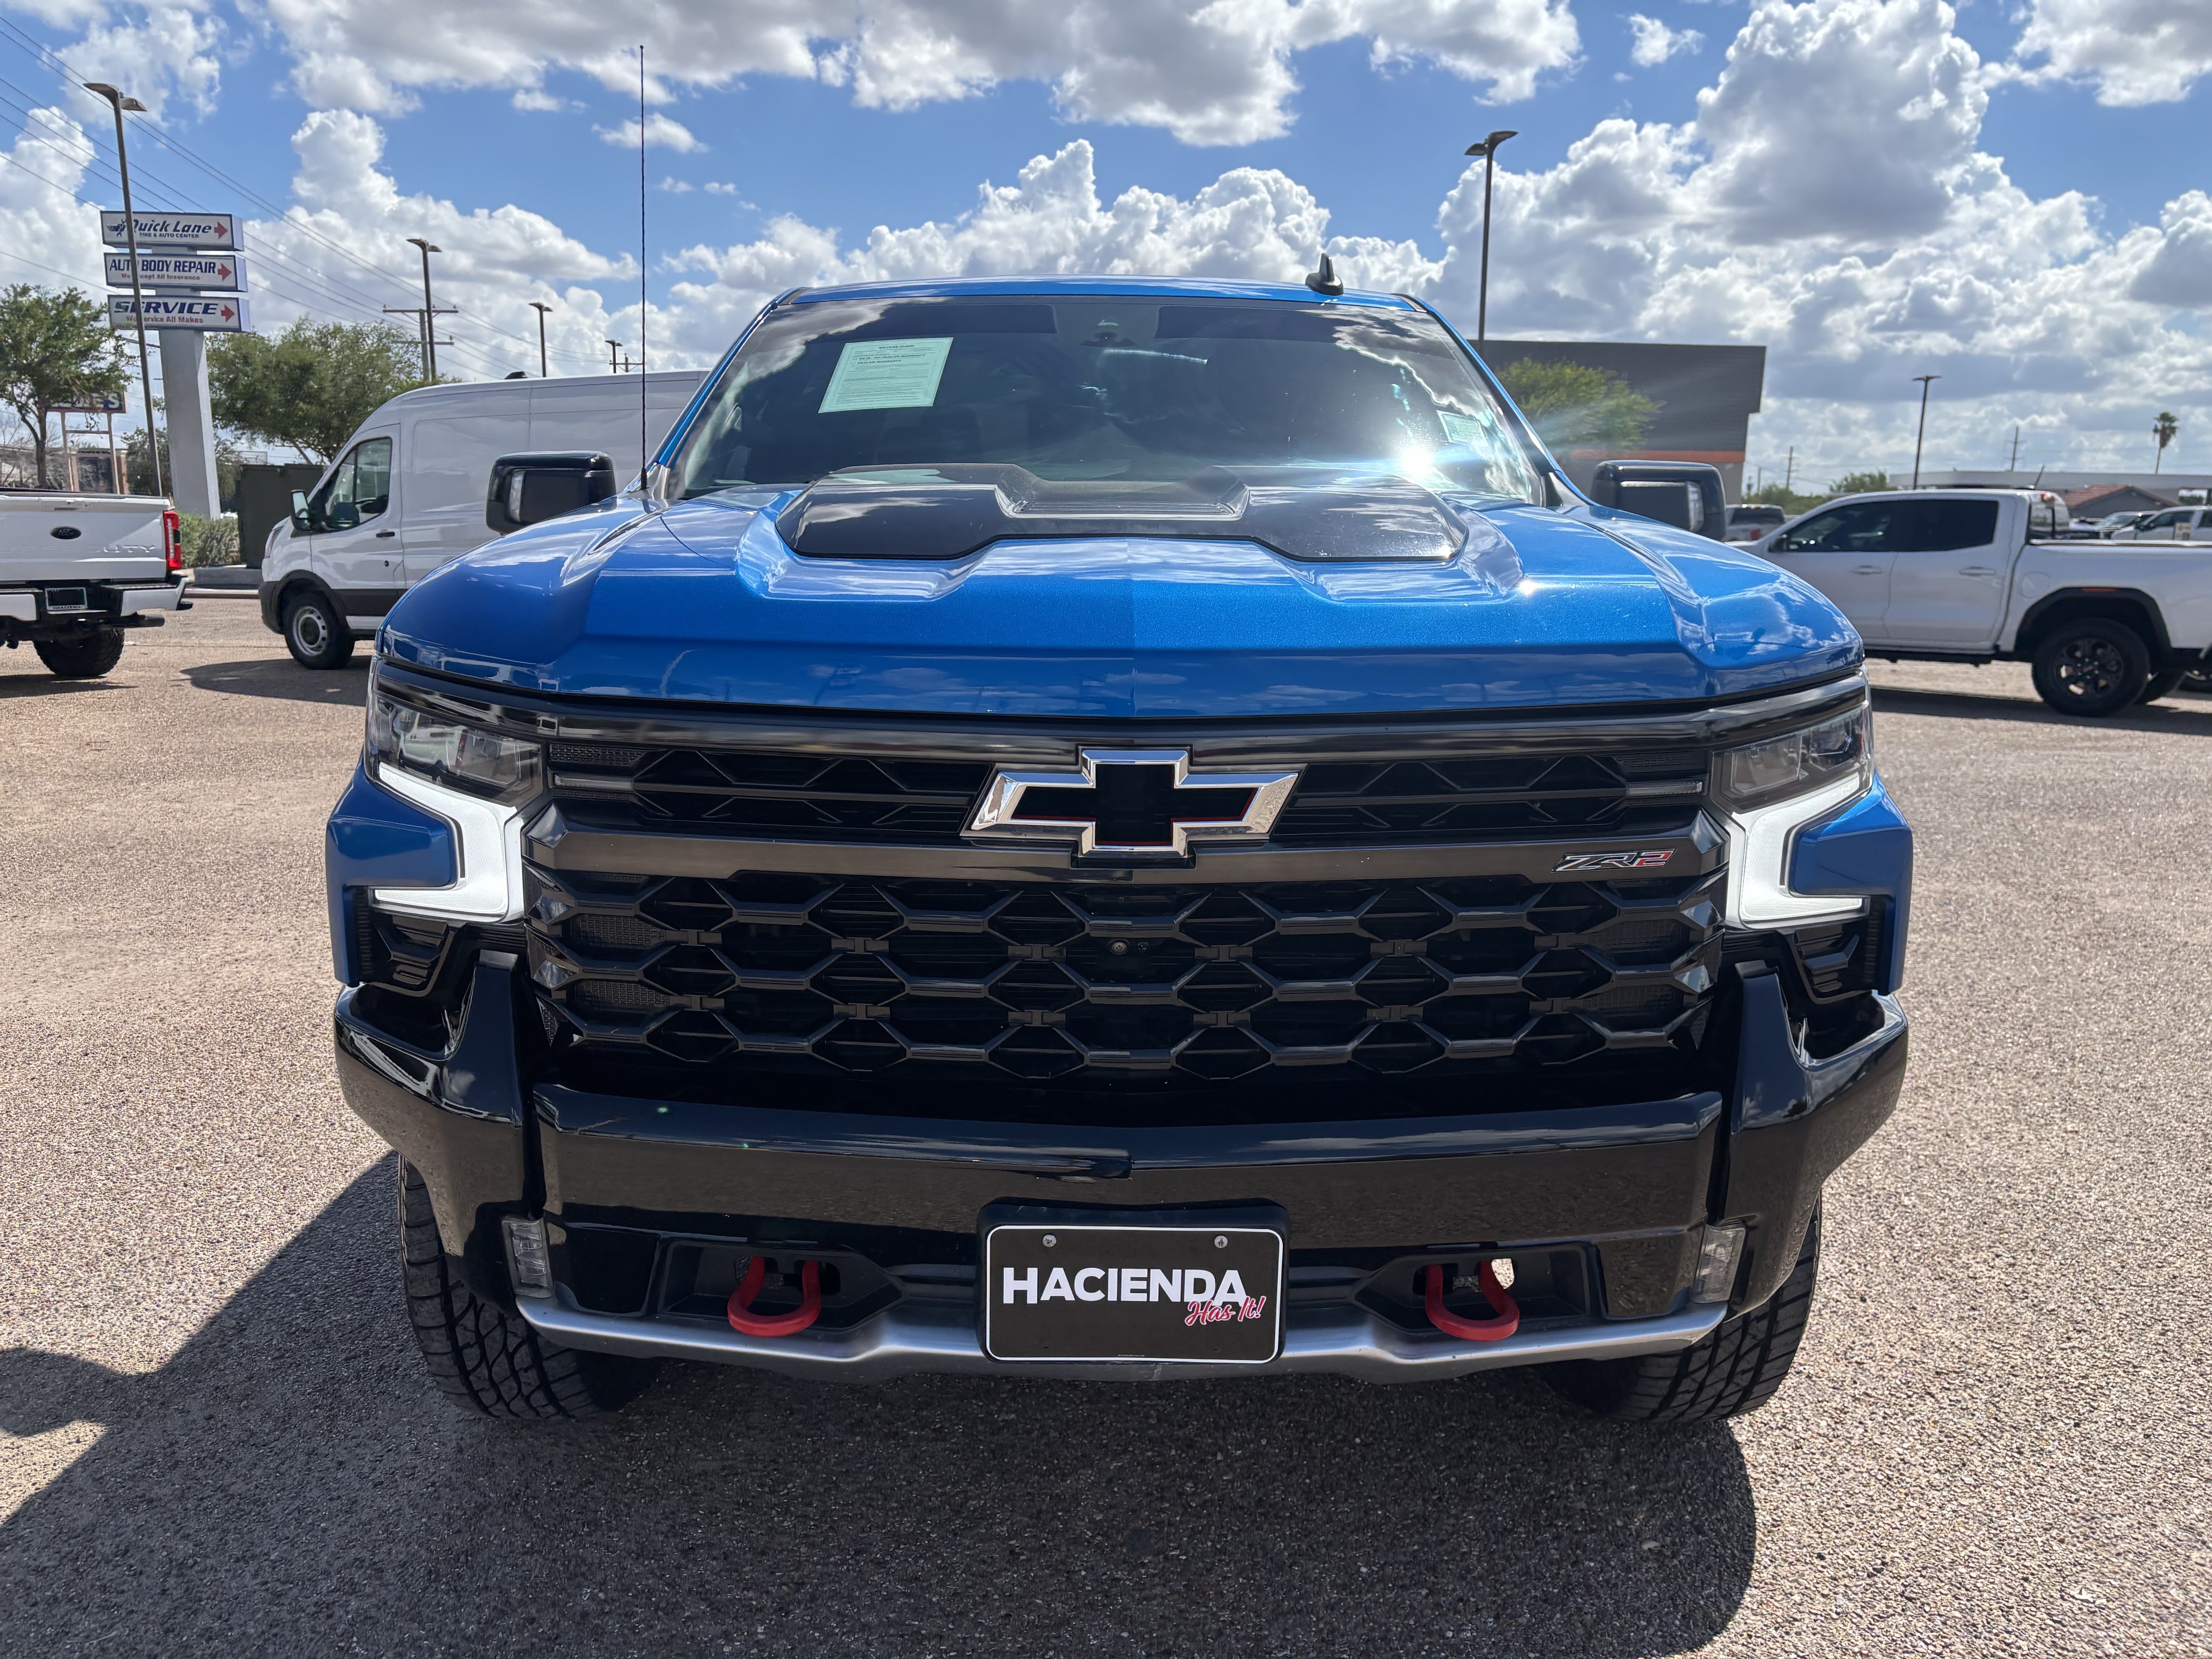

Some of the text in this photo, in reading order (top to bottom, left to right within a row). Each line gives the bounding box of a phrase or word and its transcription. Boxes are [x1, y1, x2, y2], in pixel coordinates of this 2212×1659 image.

[173, 221, 211, 233] Lane
[110, 259, 216, 273] AUT BODY REPAIR
[1553, 848, 1675, 872] ZR2
[1003, 1267, 1247, 1306] HACIENDA
[1185, 1296, 1266, 1326] Has It!
